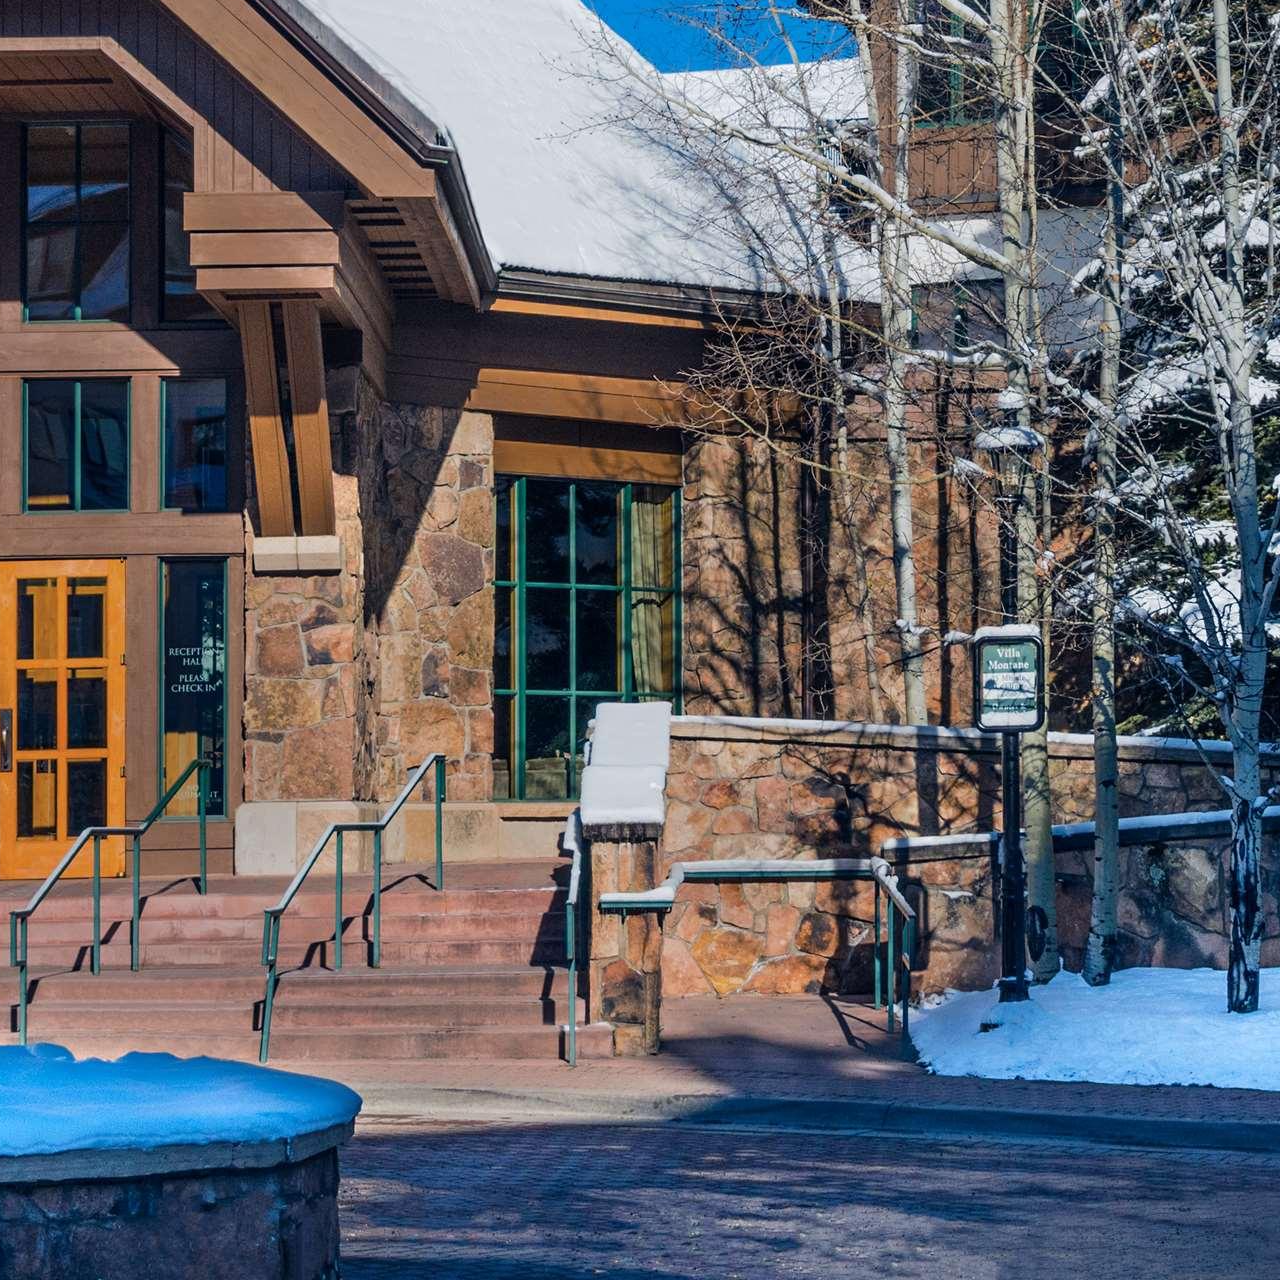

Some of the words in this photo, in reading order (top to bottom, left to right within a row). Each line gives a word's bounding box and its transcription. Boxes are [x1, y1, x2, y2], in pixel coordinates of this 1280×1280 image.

[168, 647, 219, 656] RECEPTION
[996, 648, 1021, 658] Villa
[183, 657, 207, 666] HAL
[988, 660, 1029, 670] Montane
[171, 684, 202, 693] CHECK
[205, 684, 216, 692] IN
